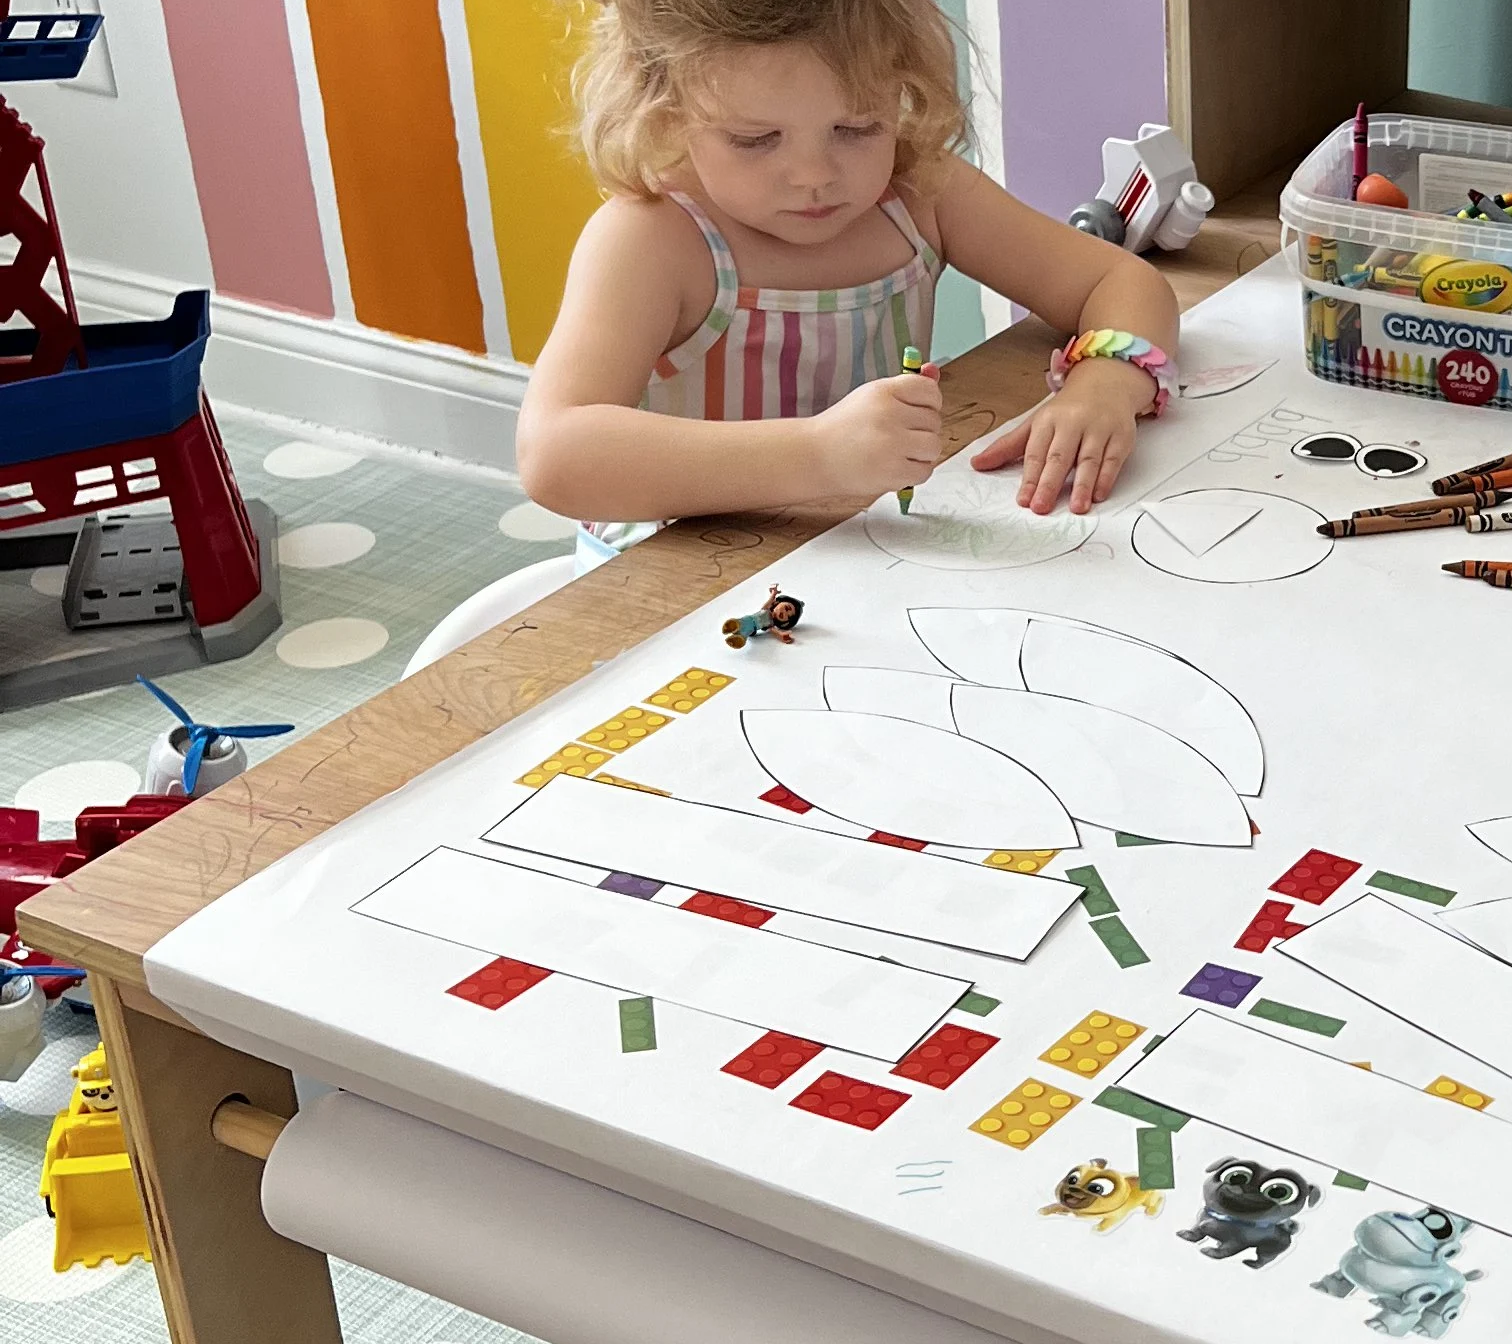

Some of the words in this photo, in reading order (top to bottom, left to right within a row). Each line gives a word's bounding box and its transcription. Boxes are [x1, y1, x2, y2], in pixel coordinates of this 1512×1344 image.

[1436, 273, 1502, 293] Crayola
[1386, 316, 1494, 352] CRAYON
[1445, 360, 1490, 385] 240
